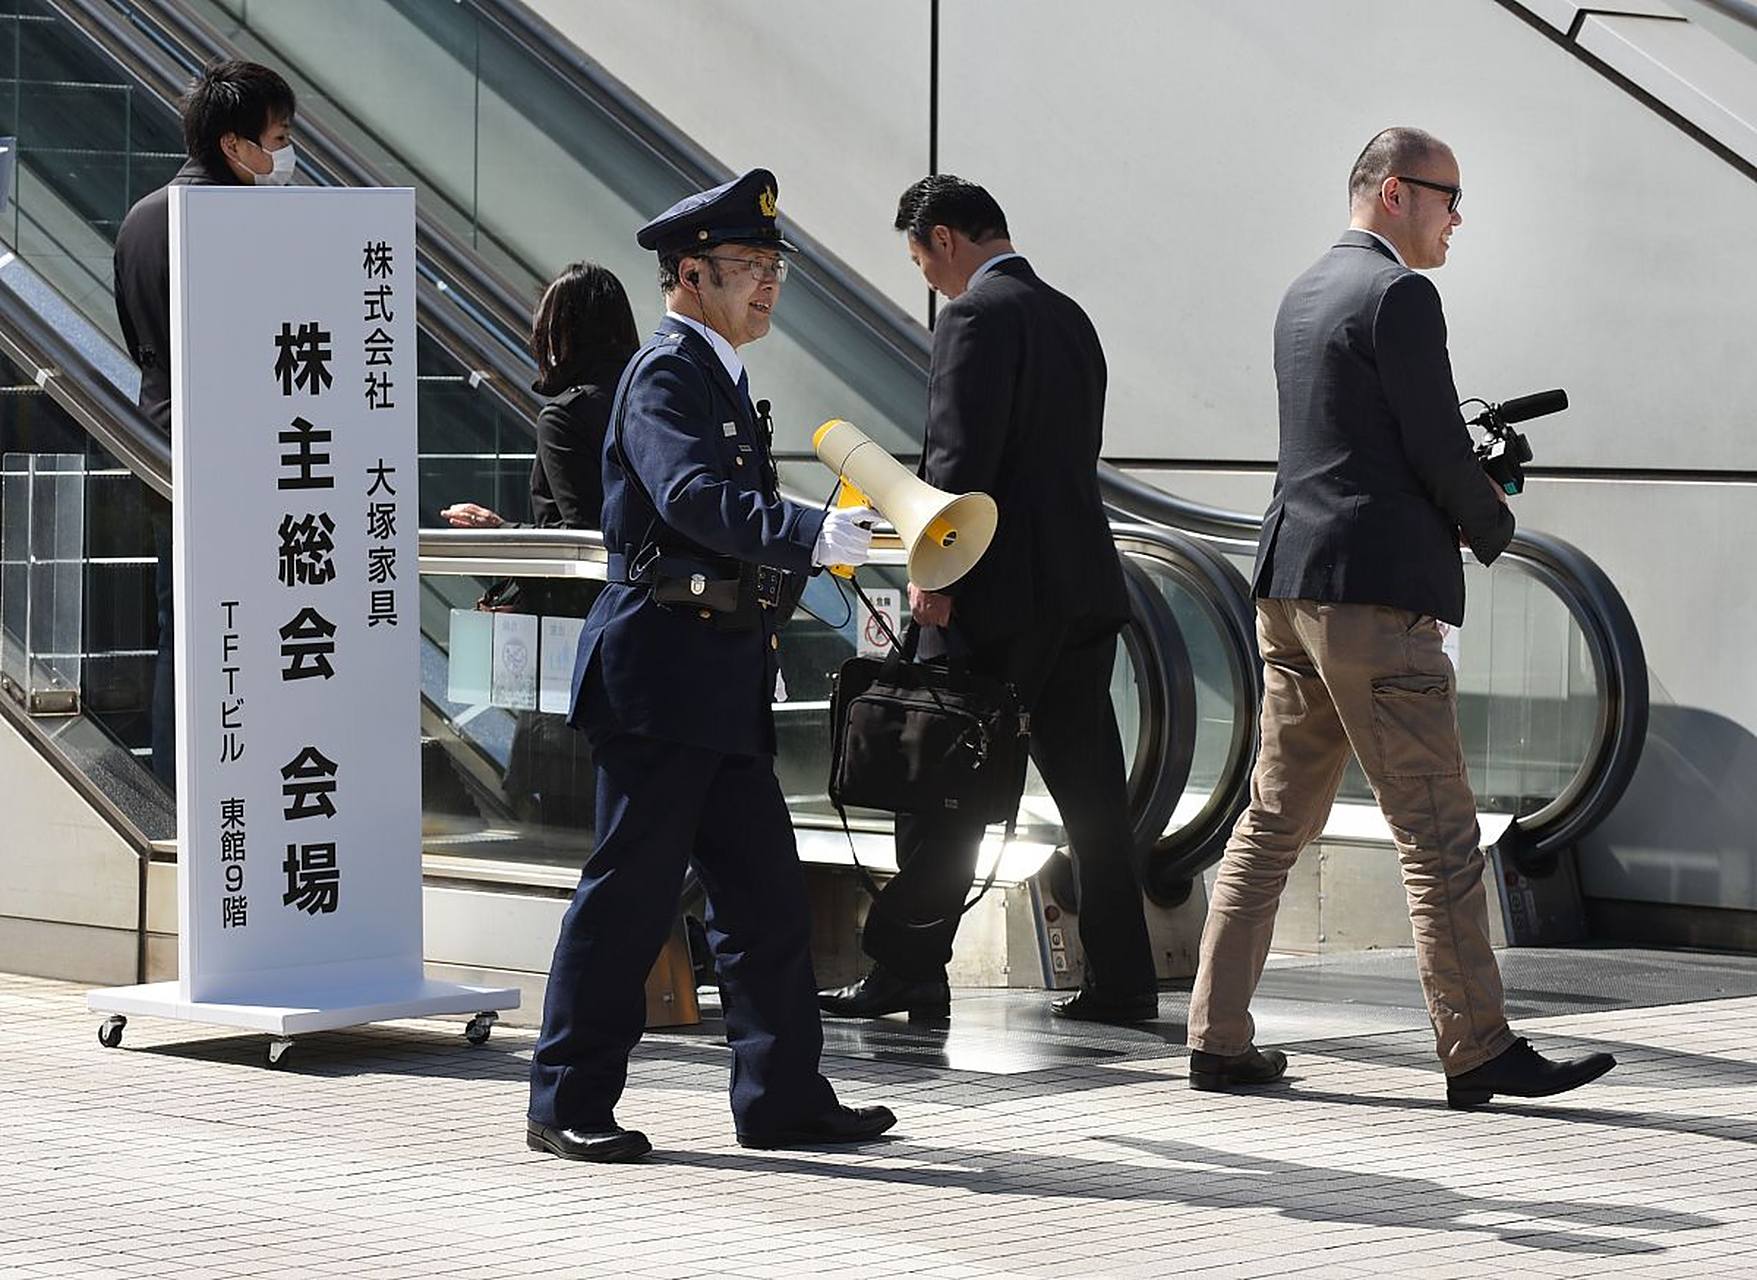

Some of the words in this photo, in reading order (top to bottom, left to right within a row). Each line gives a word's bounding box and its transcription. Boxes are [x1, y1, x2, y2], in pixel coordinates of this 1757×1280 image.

[362, 240, 395, 411] 株式会社
[274, 321, 338, 682] 株主総会
[366, 458, 398, 628] 大塚家具
[220, 601, 245, 764] TFTビル
[220, 796, 248, 929] 東館9階
[280, 746, 341, 917] 会場
